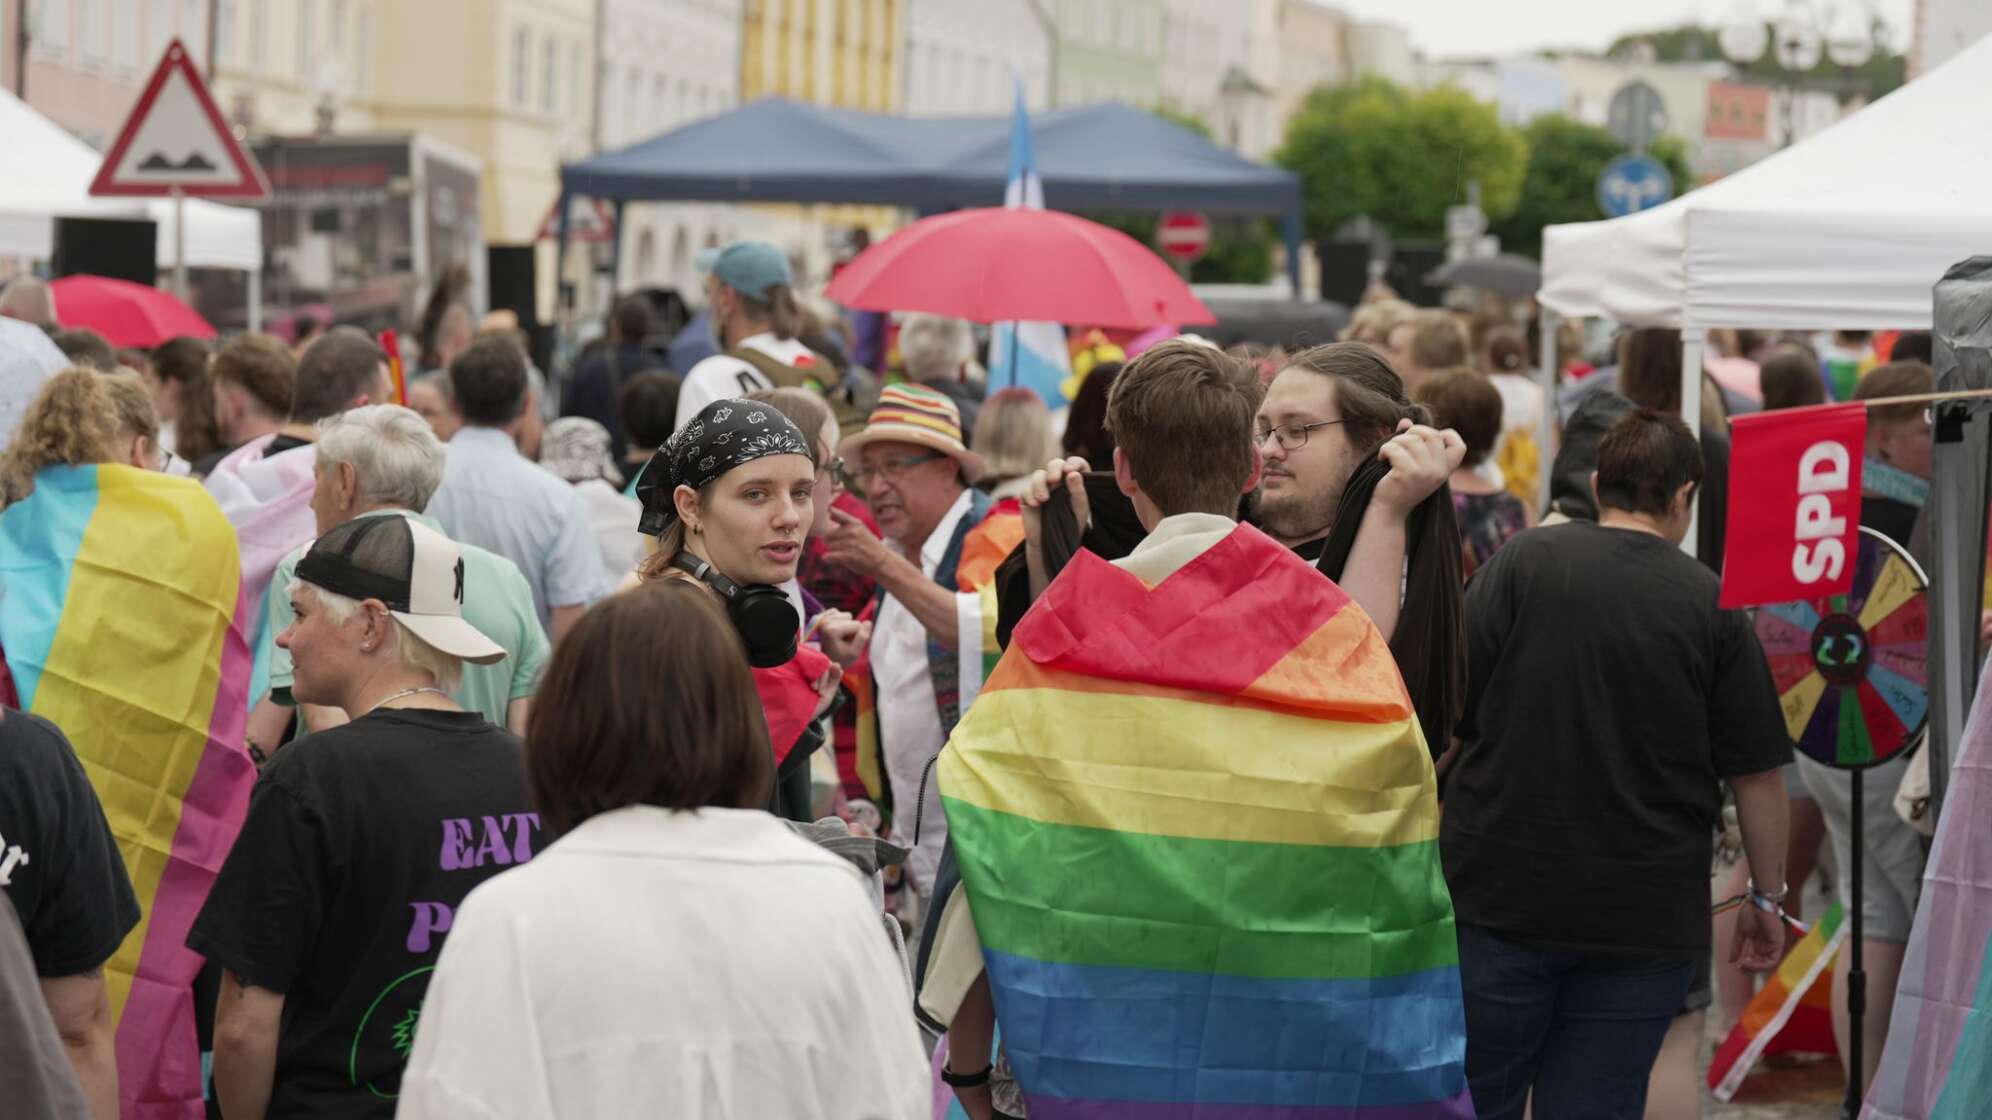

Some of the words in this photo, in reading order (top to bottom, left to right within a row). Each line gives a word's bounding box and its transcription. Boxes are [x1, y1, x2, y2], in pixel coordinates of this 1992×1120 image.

[1792, 440, 1850, 584] SPD
[440, 813, 541, 871] EAT
[406, 902, 458, 954] P
